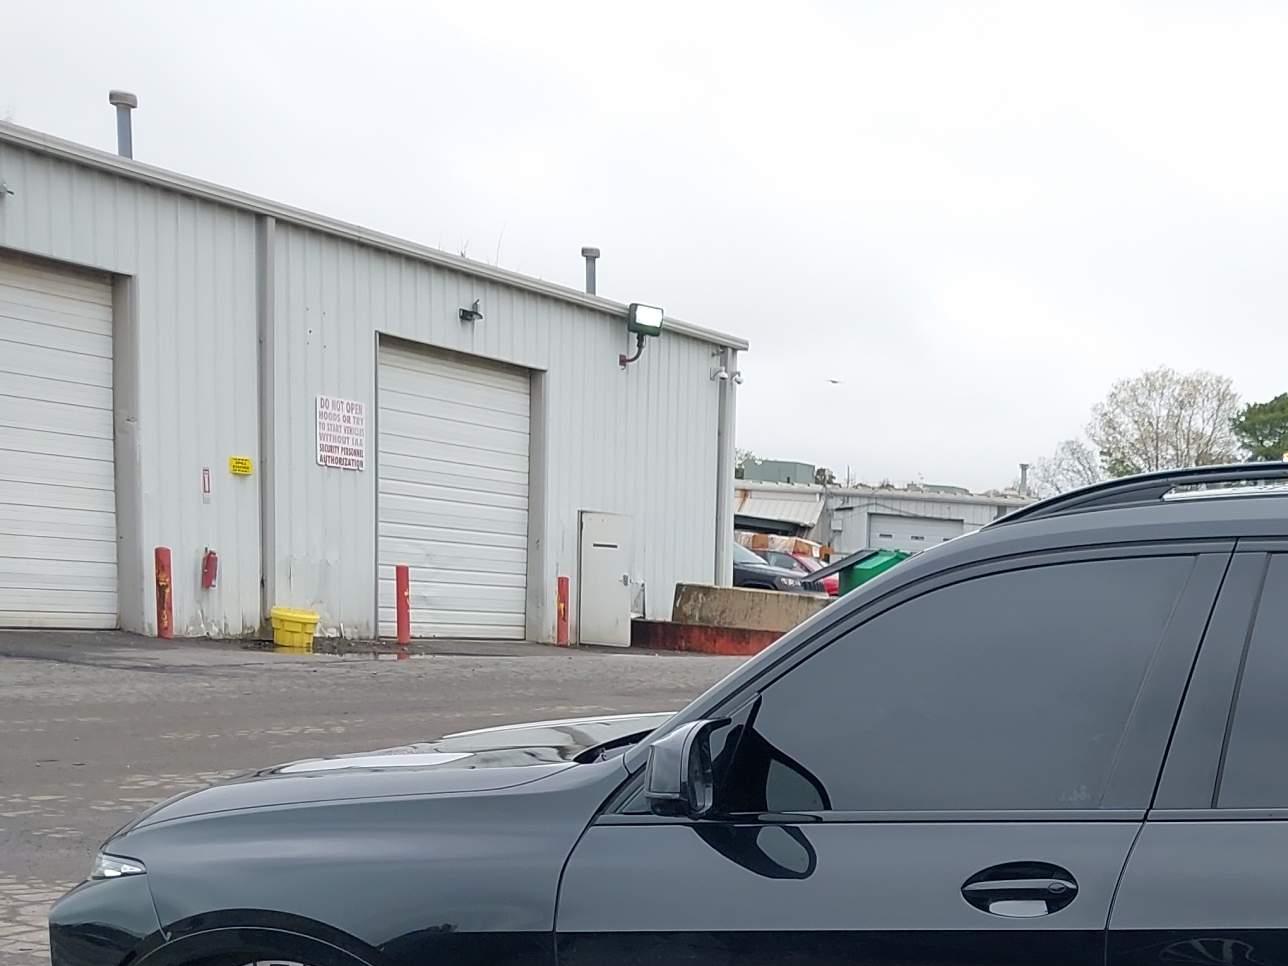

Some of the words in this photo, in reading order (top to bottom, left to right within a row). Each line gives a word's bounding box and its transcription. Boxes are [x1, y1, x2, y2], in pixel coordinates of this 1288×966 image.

[320, 398, 330, 409] DO
[332, 400, 344, 412] NOT
[346, 402, 363, 415] OPEN
[319, 411, 341, 422] HOODS
[343, 415, 352, 424] OR
[353, 416, 364, 426] TRY
[319, 422, 326, 431] TO
[327, 424, 342, 433] START
[344, 426, 364, 437] VEHICLES
[319, 433, 350, 444] WITHOUT
[319, 443, 340, 453] SECURITY
[340, 447, 364, 458] PERSONNEL
[319, 455, 364, 468] AUTHORIZATION
